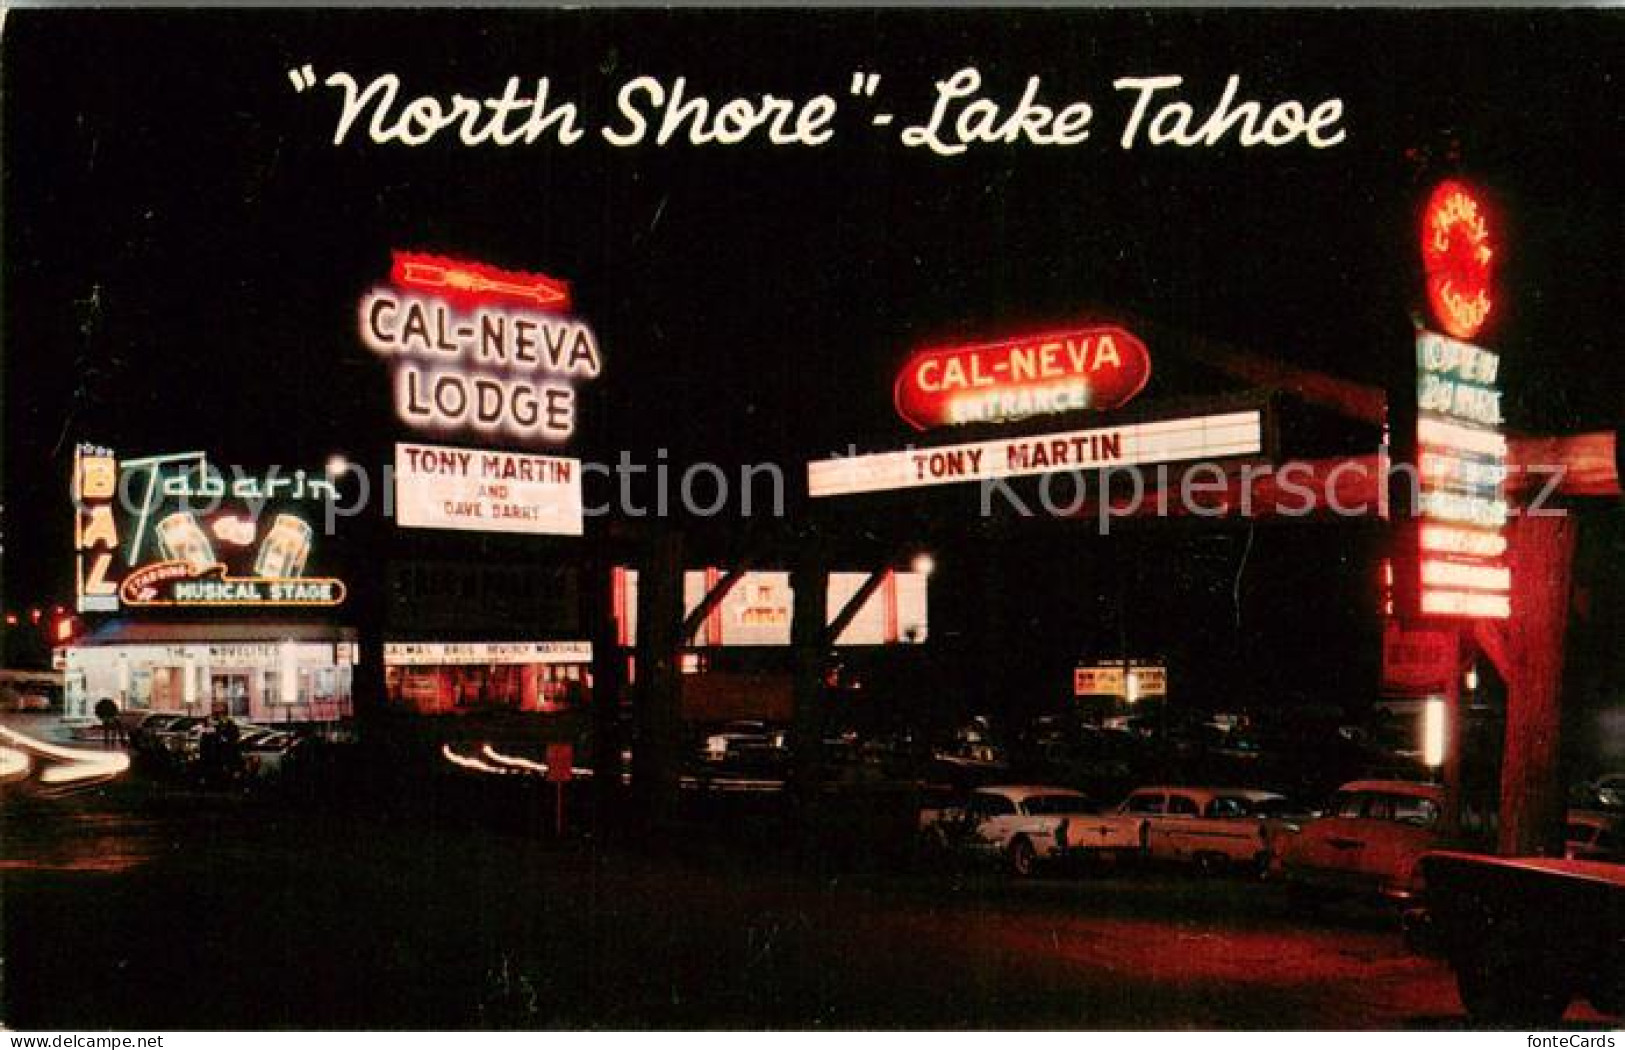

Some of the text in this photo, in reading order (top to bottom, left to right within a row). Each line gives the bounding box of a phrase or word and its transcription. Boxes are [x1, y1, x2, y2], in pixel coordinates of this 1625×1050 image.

[368, 297, 598, 372] CAL-NEVA
[916, 334, 1122, 392] CAL-NEVA
[407, 371, 572, 432] LODGE
[404, 448, 572, 484] TONY MARTIN
[912, 448, 984, 480] TONY
[1005, 431, 1122, 470] MARTIN
[120, 450, 342, 567] Tabarin
[477, 485, 509, 500] AND
[82, 457, 119, 595] BAL
[175, 581, 262, 601] MUSICAL
[270, 582, 333, 601] STAGE
